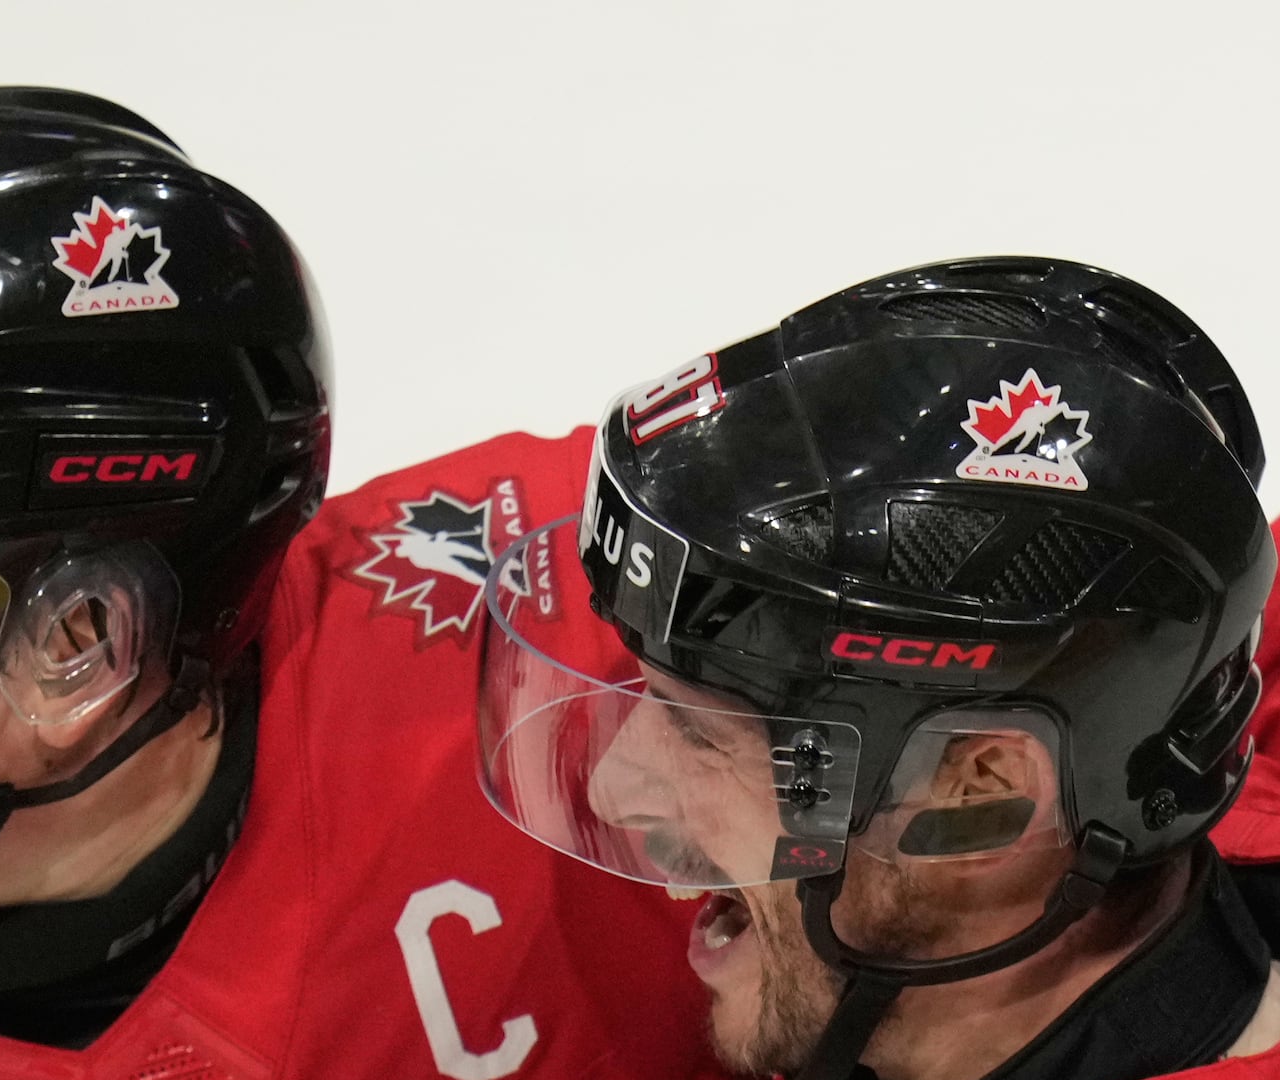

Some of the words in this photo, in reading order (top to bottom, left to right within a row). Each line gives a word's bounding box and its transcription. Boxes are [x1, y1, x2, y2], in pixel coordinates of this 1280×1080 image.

[71, 294, 173, 313] CANADA
[628, 352, 726, 446] 87
[49, 452, 199, 483] CCM
[965, 465, 1079, 487] CANADA
[830, 631, 997, 670] CCM
